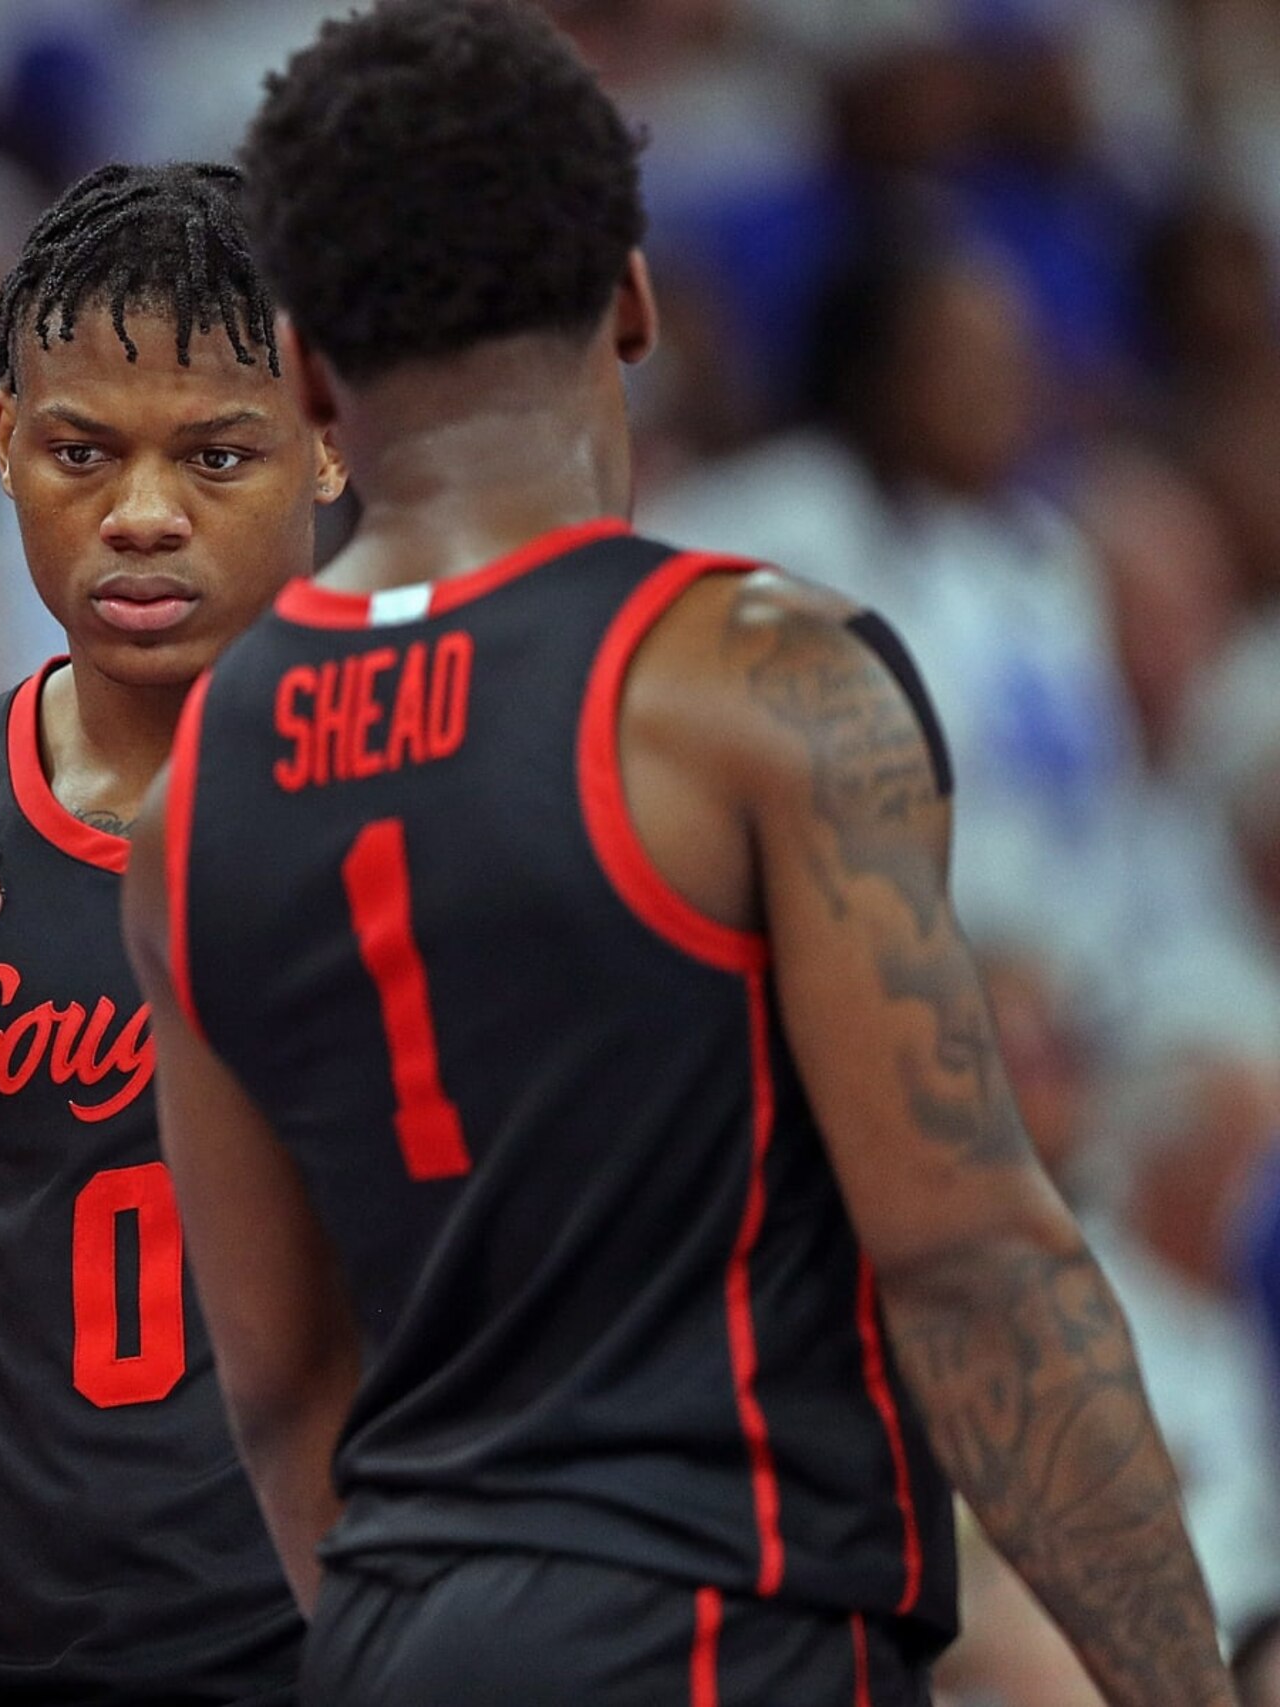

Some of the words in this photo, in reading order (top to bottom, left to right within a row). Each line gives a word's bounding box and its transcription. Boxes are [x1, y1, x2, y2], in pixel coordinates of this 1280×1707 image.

[274, 630, 475, 792] SHEAD
[342, 818, 473, 1182] 1
[72, 1161, 186, 1409] 0
